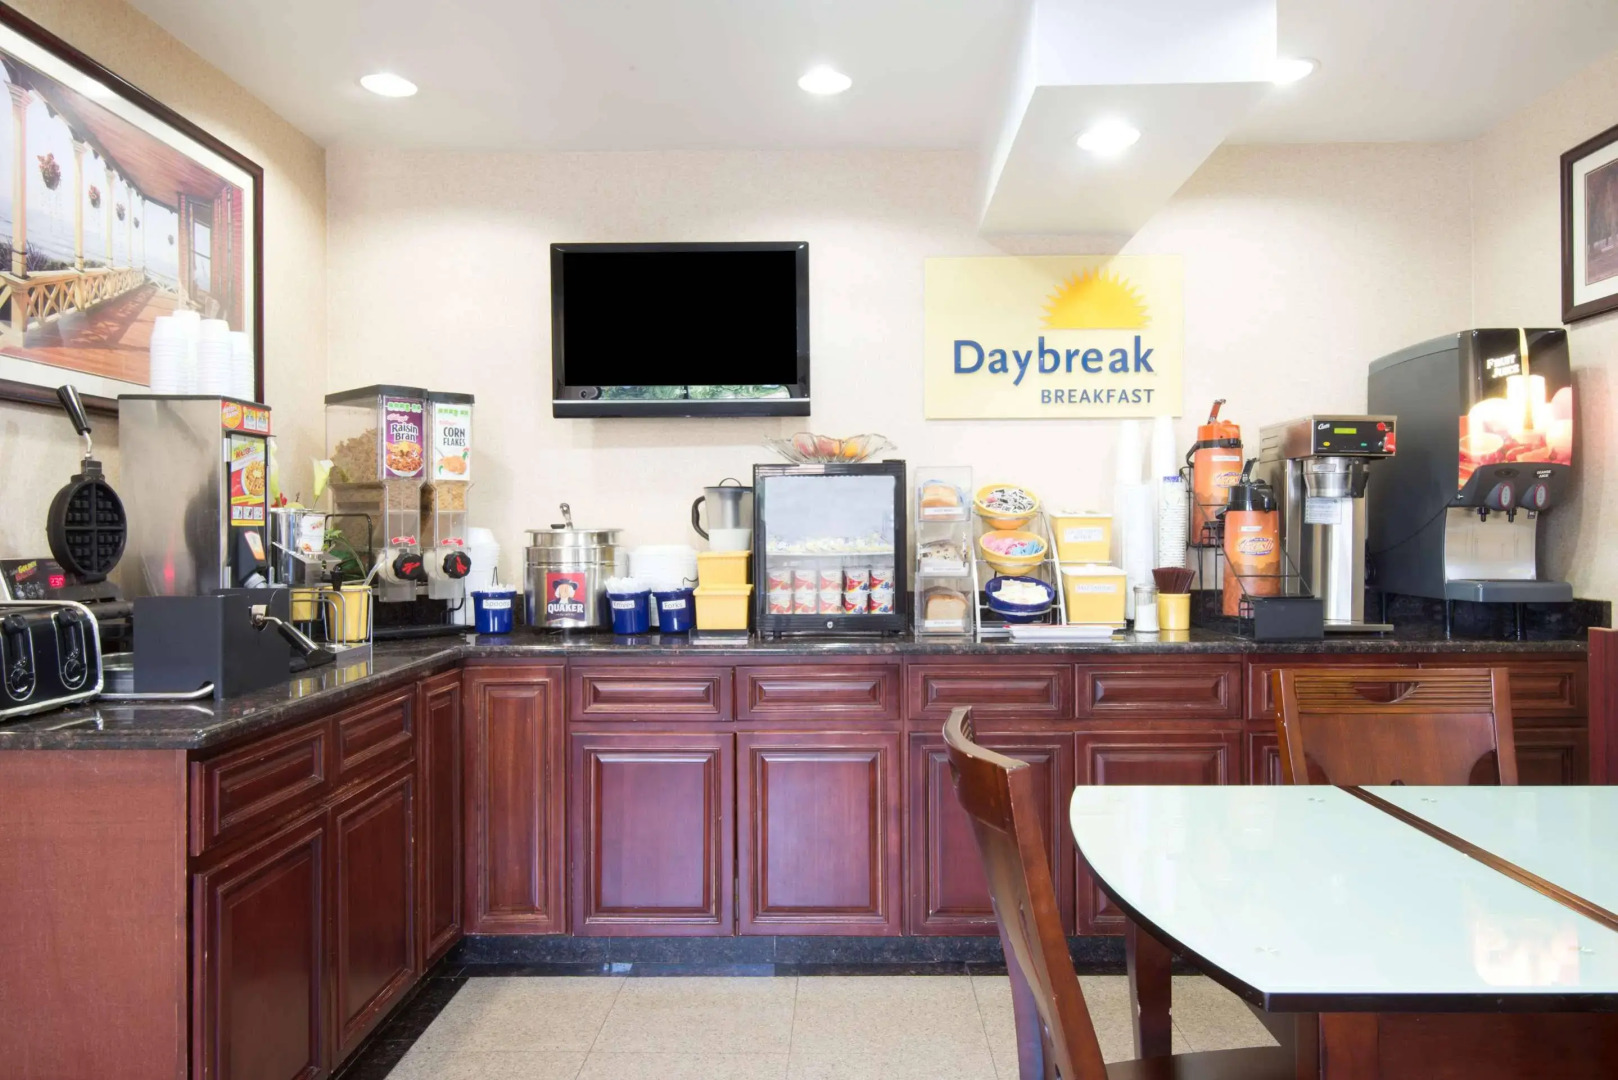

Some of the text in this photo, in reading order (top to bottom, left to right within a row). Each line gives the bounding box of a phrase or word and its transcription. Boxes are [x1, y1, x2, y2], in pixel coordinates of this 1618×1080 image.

[954, 335, 1155, 386] Daybreak
[1041, 388, 1155, 404] BREAKFAST
[391, 422, 418, 434] Raisin
[443, 426, 466, 438] CORN
[395, 432, 416, 442] Bran
[443, 437, 466, 447] FLAKES
[547, 603, 584, 614] QUAKER
[664, 601, 683, 609] Forks
